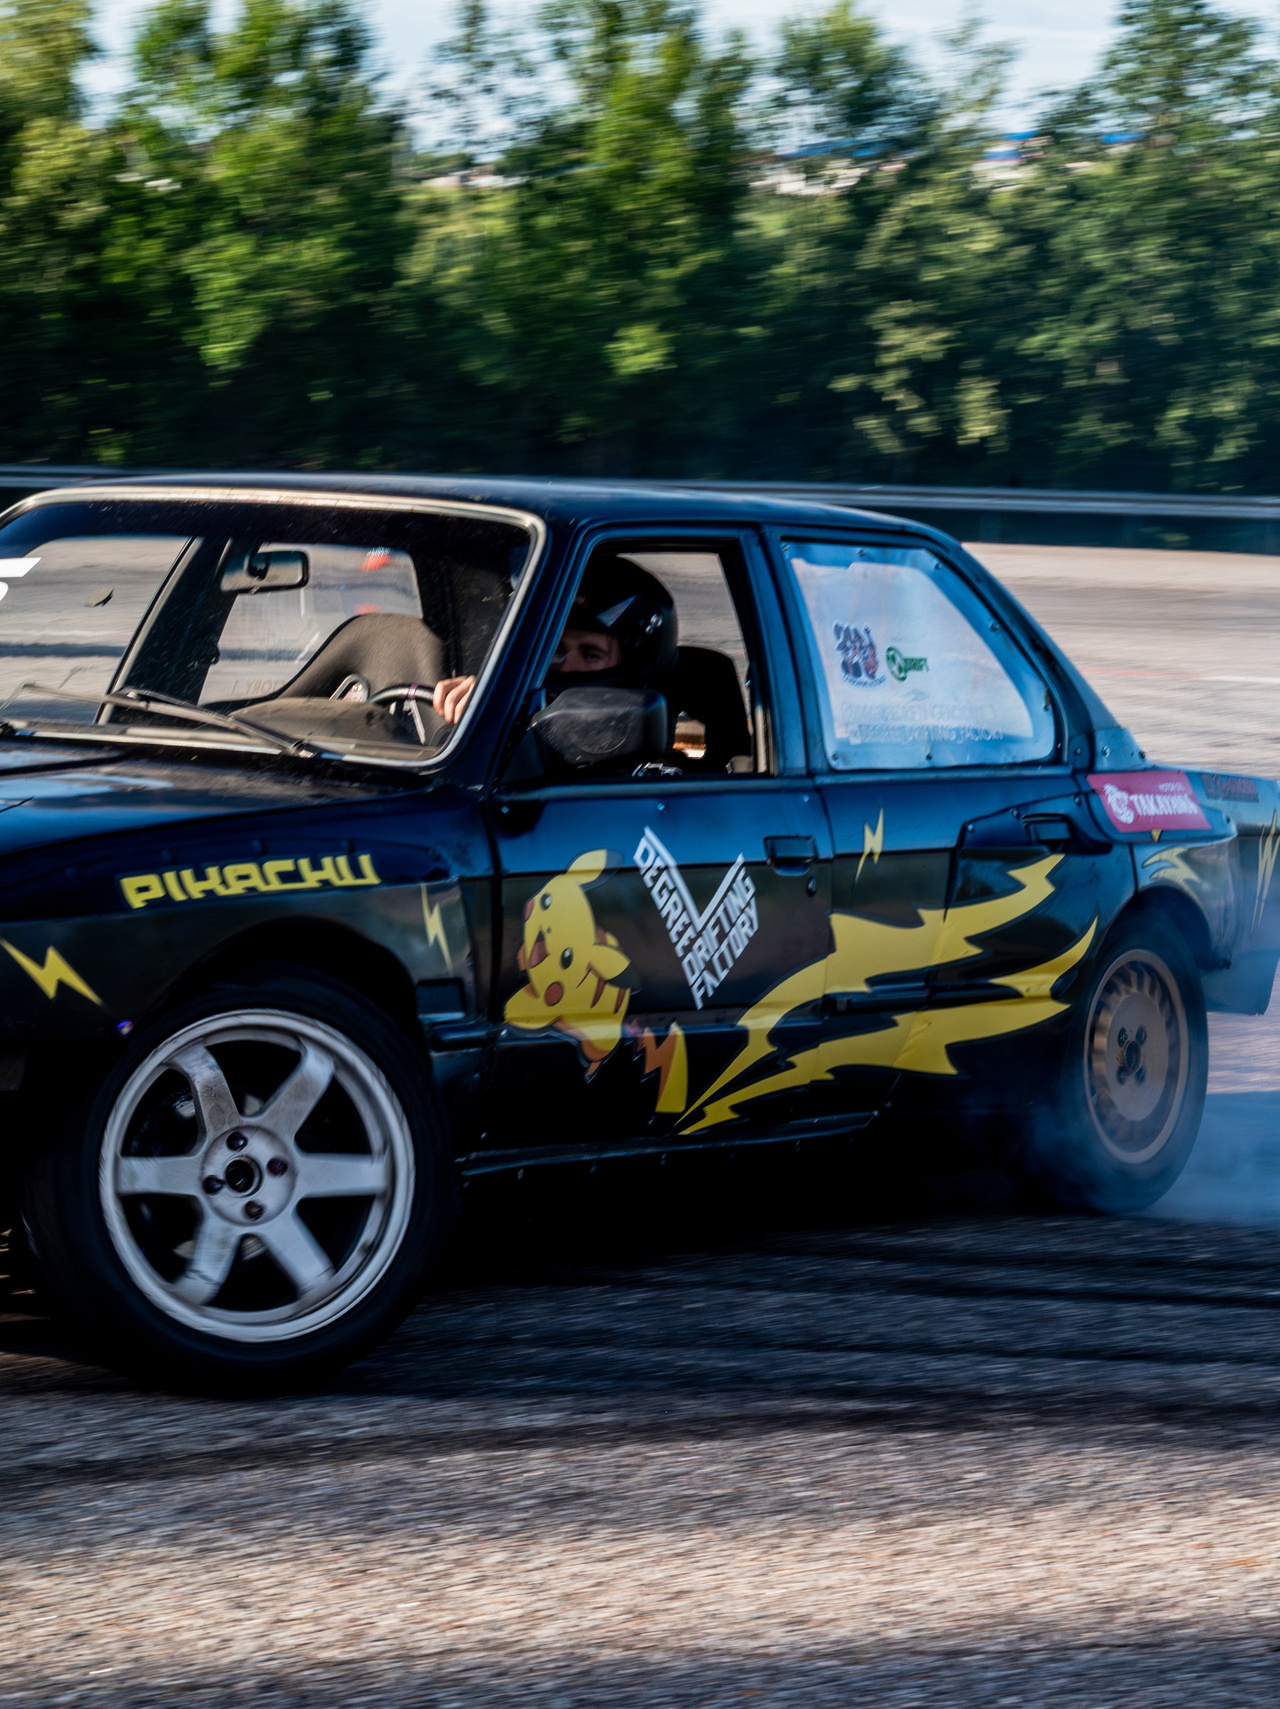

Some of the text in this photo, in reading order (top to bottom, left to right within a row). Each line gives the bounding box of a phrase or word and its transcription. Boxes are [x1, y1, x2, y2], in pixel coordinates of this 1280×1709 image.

[1128, 794, 1199, 816] TAKAYAMA
[120, 854, 381, 909] PIKACHU
[633, 836, 697, 958] DEGREE
[681, 867, 756, 986] DRIFTING
[691, 897, 760, 1010] FACTORY
